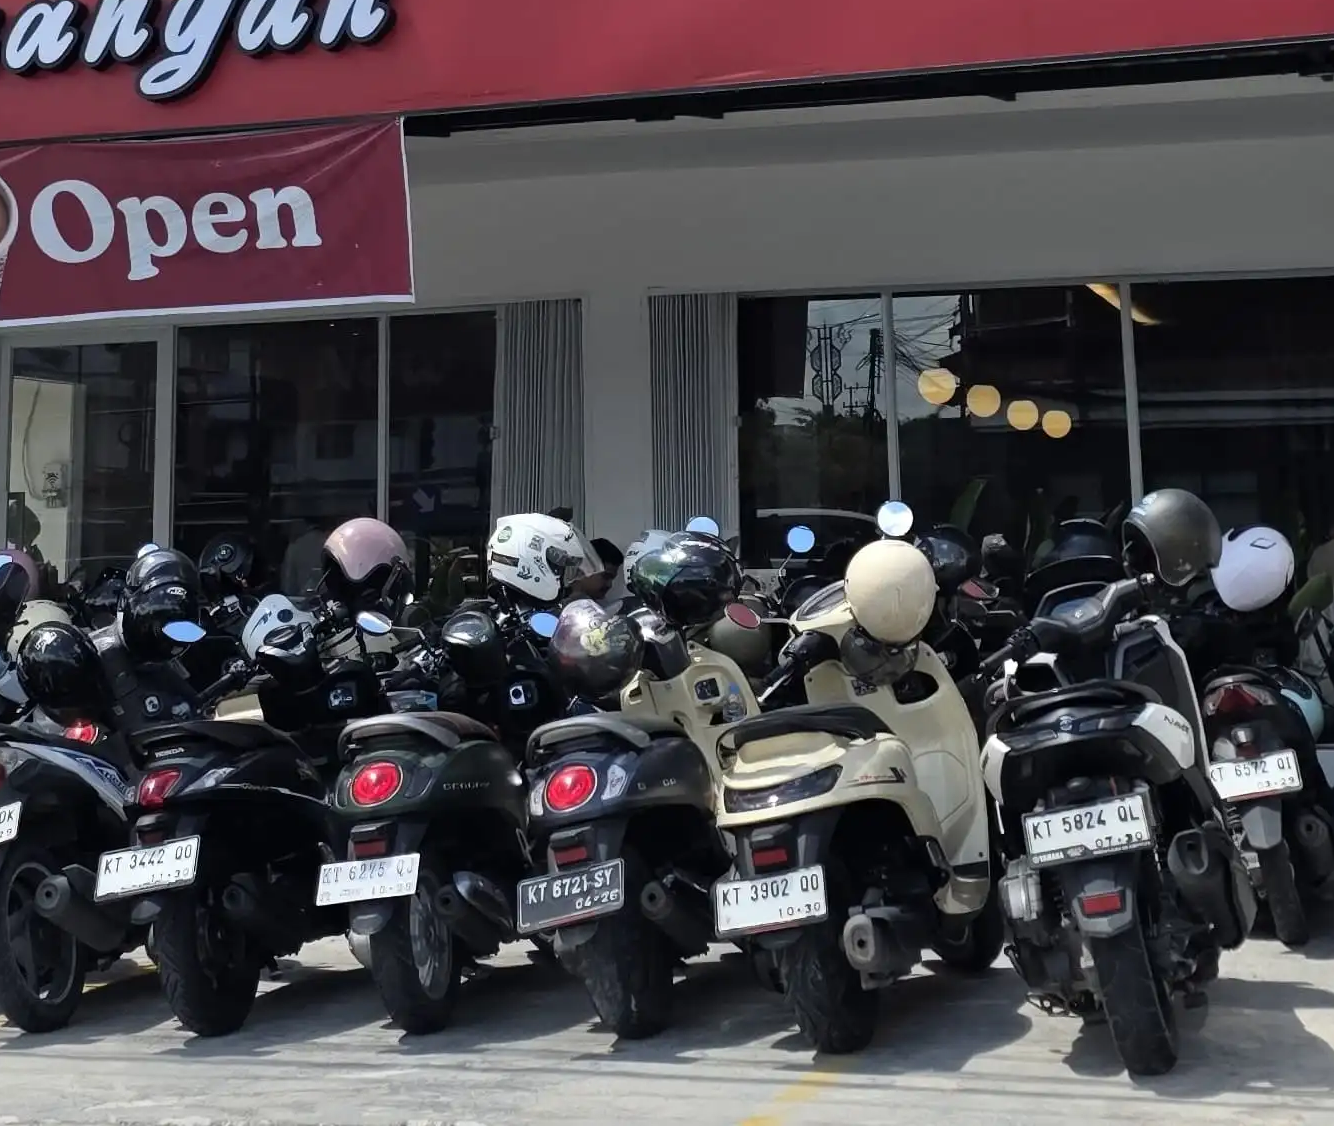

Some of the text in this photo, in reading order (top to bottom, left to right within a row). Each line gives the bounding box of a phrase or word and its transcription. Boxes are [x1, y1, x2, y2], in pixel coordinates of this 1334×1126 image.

[29, 178, 323, 281] Open
[1234, 759, 1269, 778] 6572
[1031, 805, 1140, 841] KT 5824 QL
[104, 856, 123, 875] KT
[129, 848, 166, 870] 3442
[322, 867, 342, 884] KT
[528, 867, 614, 905] KT 6721 SY
[722, 887, 741, 907] KT
[750, 878, 790, 902] 3902
